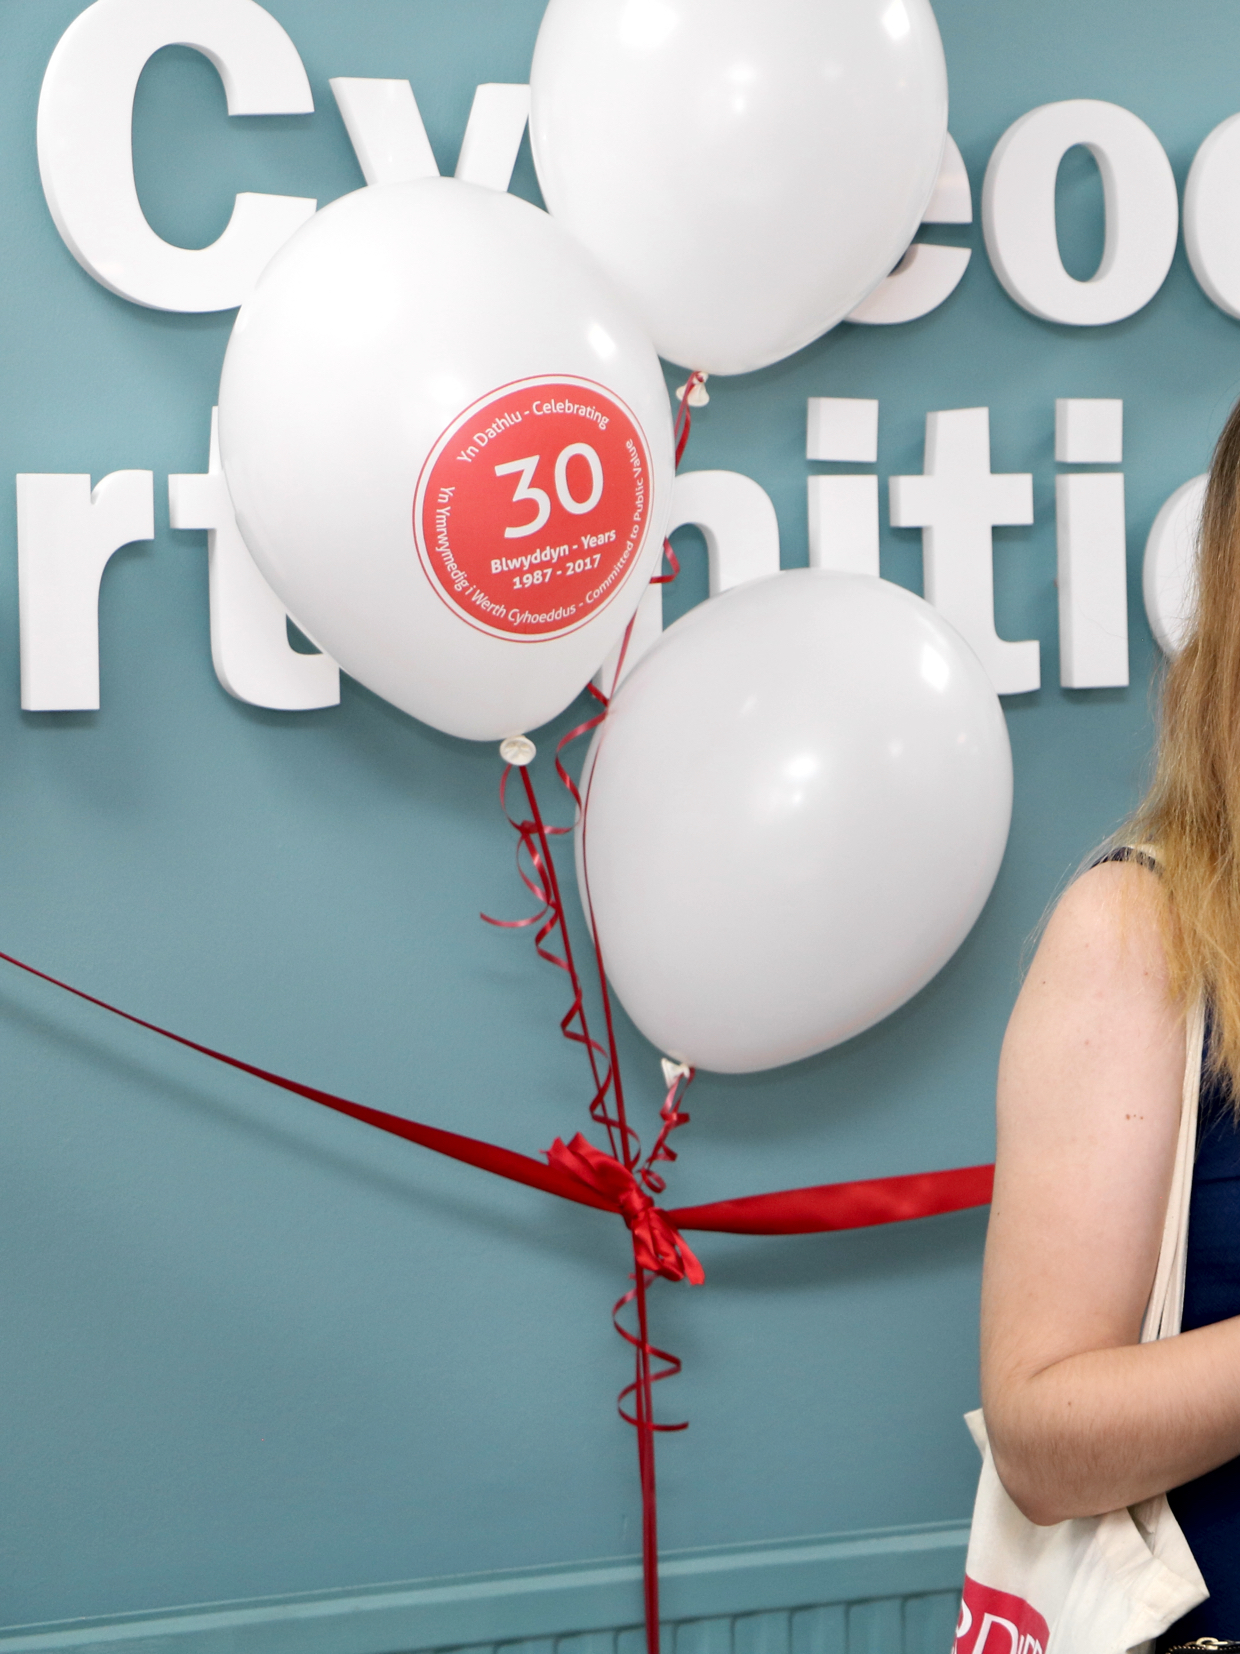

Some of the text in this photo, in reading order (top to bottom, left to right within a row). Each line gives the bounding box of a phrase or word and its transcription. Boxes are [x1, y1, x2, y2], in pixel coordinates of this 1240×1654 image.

[456, 445, 479, 463] Yn
[473, 411, 522, 447] Dathlu
[532, 399, 610, 430] Celebrating
[625, 438, 642, 478] Value
[437, 486, 455, 503] Yn
[494, 442, 604, 538] 30
[633, 477, 644, 521] Public
[435, 506, 469, 591] Ymrwymedig
[490, 544, 569, 574] Blwyddyn
[581, 530, 616, 549] Years
[630, 524, 639, 538] to
[513, 568, 553, 589] 1987
[565, 553, 601, 576] 2017
[585, 540, 634, 604] Committed
[471, 589, 506, 618] Werth
[508, 604, 576, 626] Cyhoeddus
